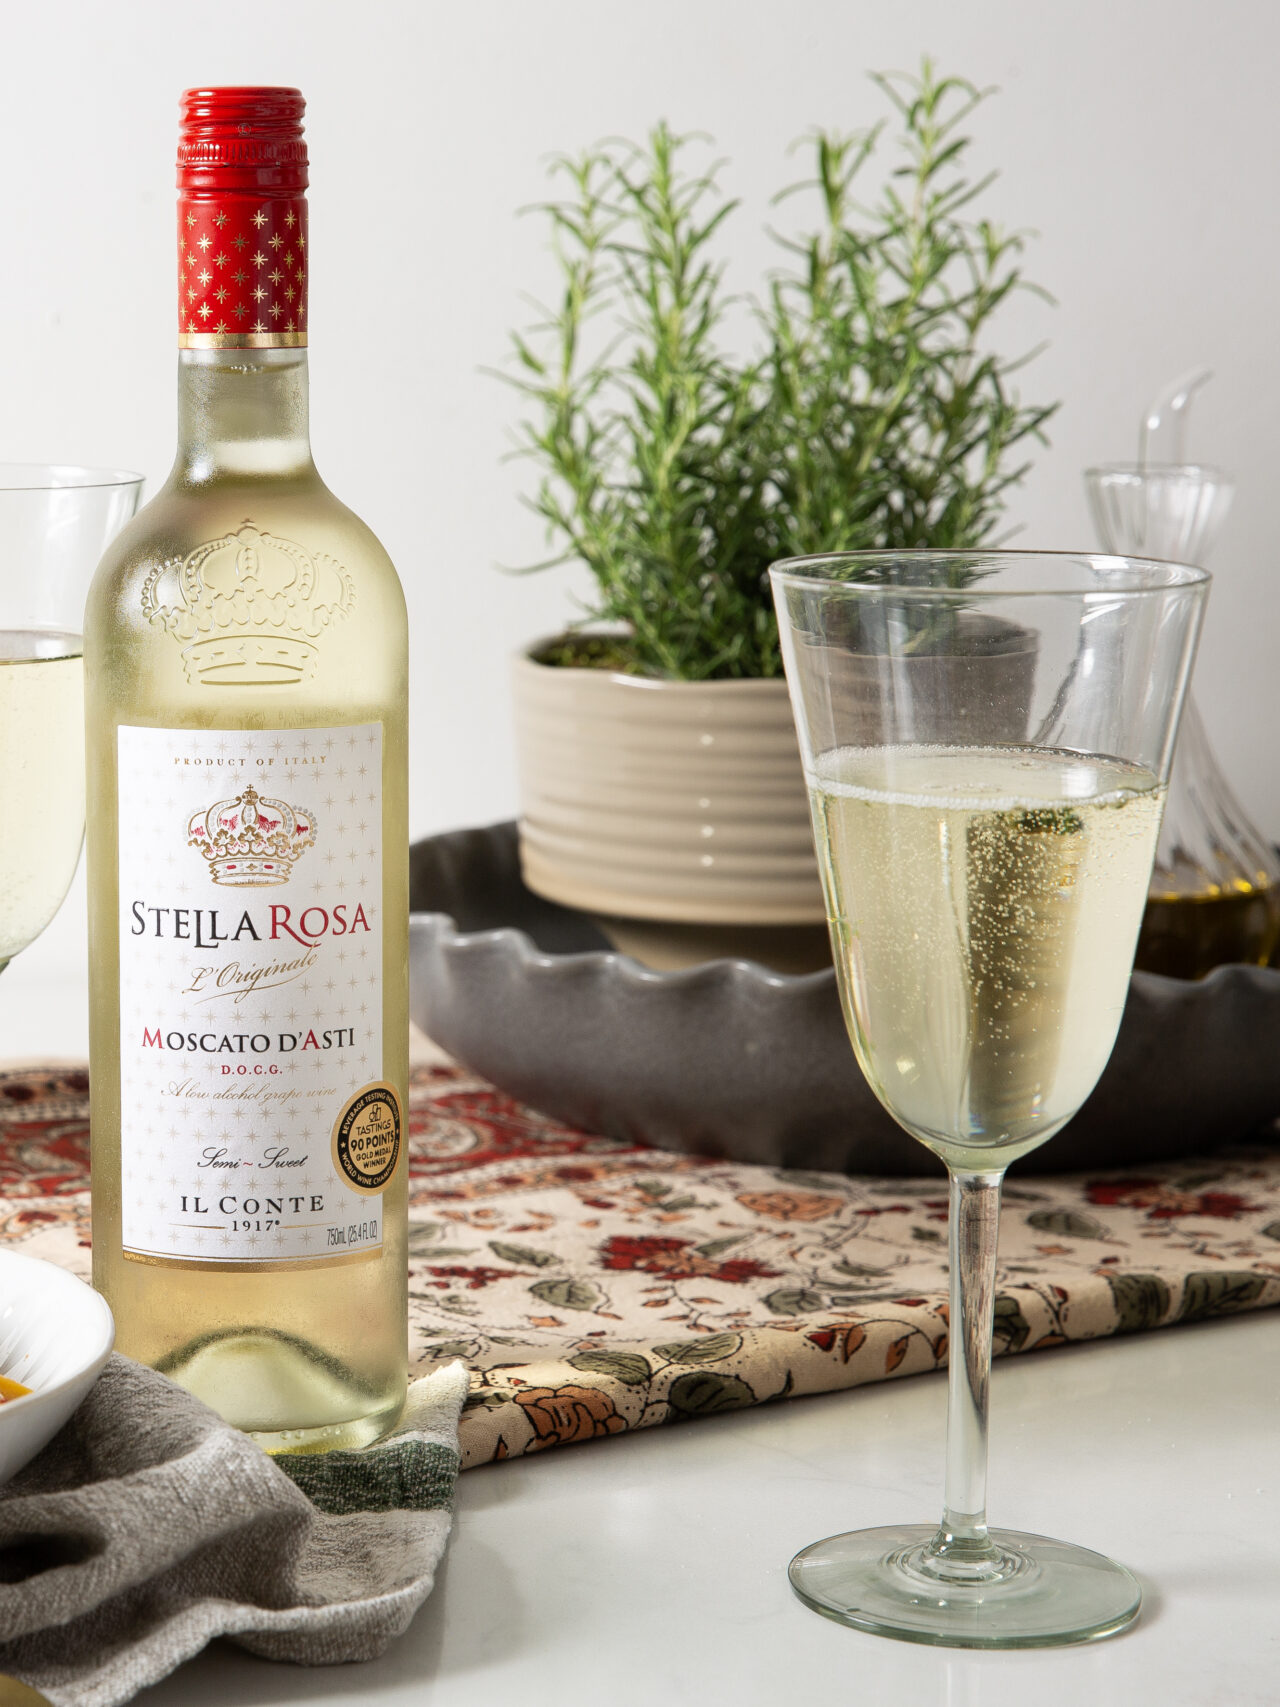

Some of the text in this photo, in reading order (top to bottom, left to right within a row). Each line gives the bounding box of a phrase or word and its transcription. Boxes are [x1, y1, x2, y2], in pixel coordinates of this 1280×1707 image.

[174, 755, 328, 767] PRODUCT OF ITALY
[130, 900, 372, 949] STELLA ROSA
[181, 941, 320, 1005] L'Originale
[141, 1026, 356, 1053] MOSCATO D'ASTI
[220, 1064, 284, 1076] D.O.C.G.
[161, 1077, 338, 1107] A low alcohol grape wine
[341, 1099, 366, 1135] BEVERAGE
[364, 1091, 387, 1103] TESTING
[355, 1119, 392, 1136] TASTINGS
[350, 1130, 394, 1152] 90 POINTS
[196, 1146, 241, 1170] Semi
[257, 1147, 309, 1170] Sweet
[355, 1146, 392, 1162] GOLD MEDAL
[362, 1157, 387, 1169] WINNER
[341, 1151, 357, 1177] WORLD
[356, 1174, 373, 1186] WINE
[180, 1195, 325, 1215] IL CONTE
